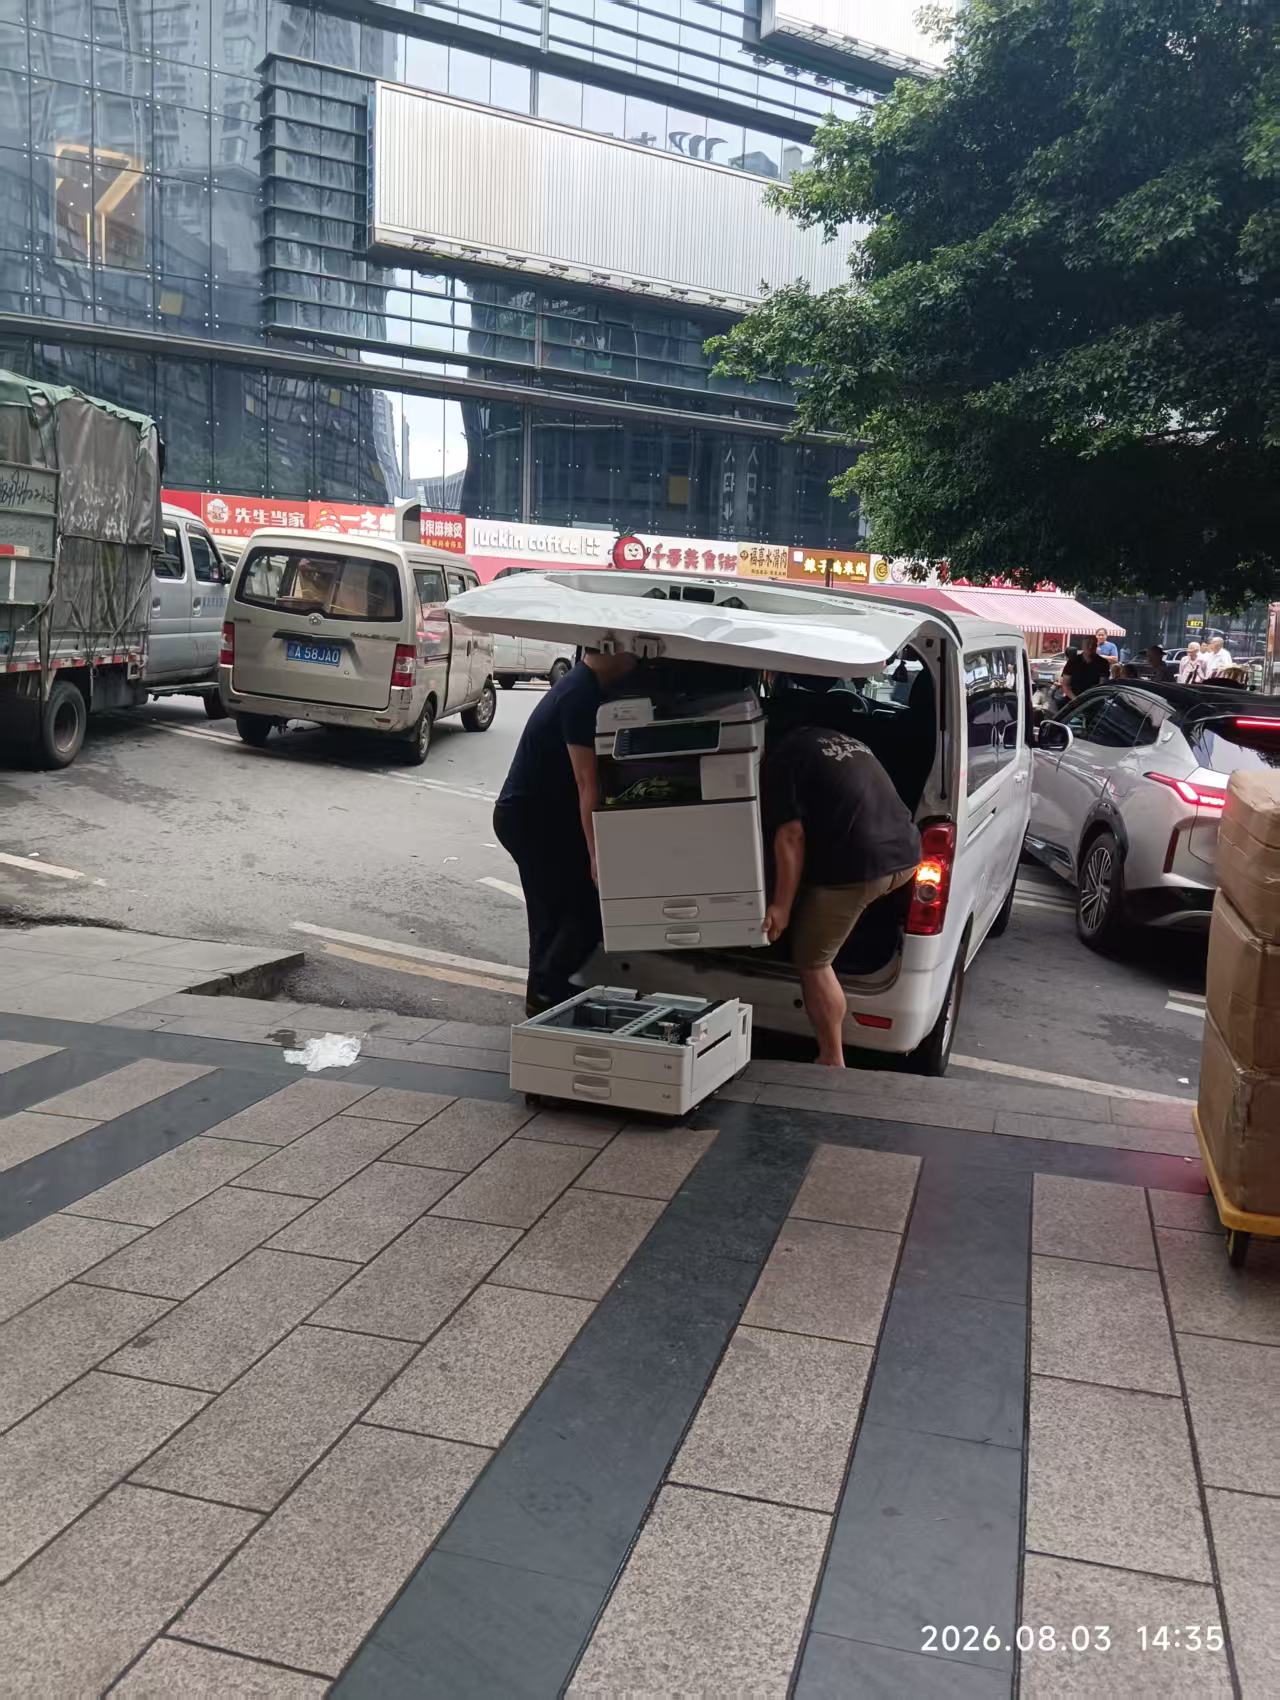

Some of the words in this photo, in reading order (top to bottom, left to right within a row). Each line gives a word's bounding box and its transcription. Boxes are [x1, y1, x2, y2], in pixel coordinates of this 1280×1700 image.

[235, 507, 305, 528] 先生当家
[473, 527, 524, 550] luckin
[528, 535, 577, 555] coffee
